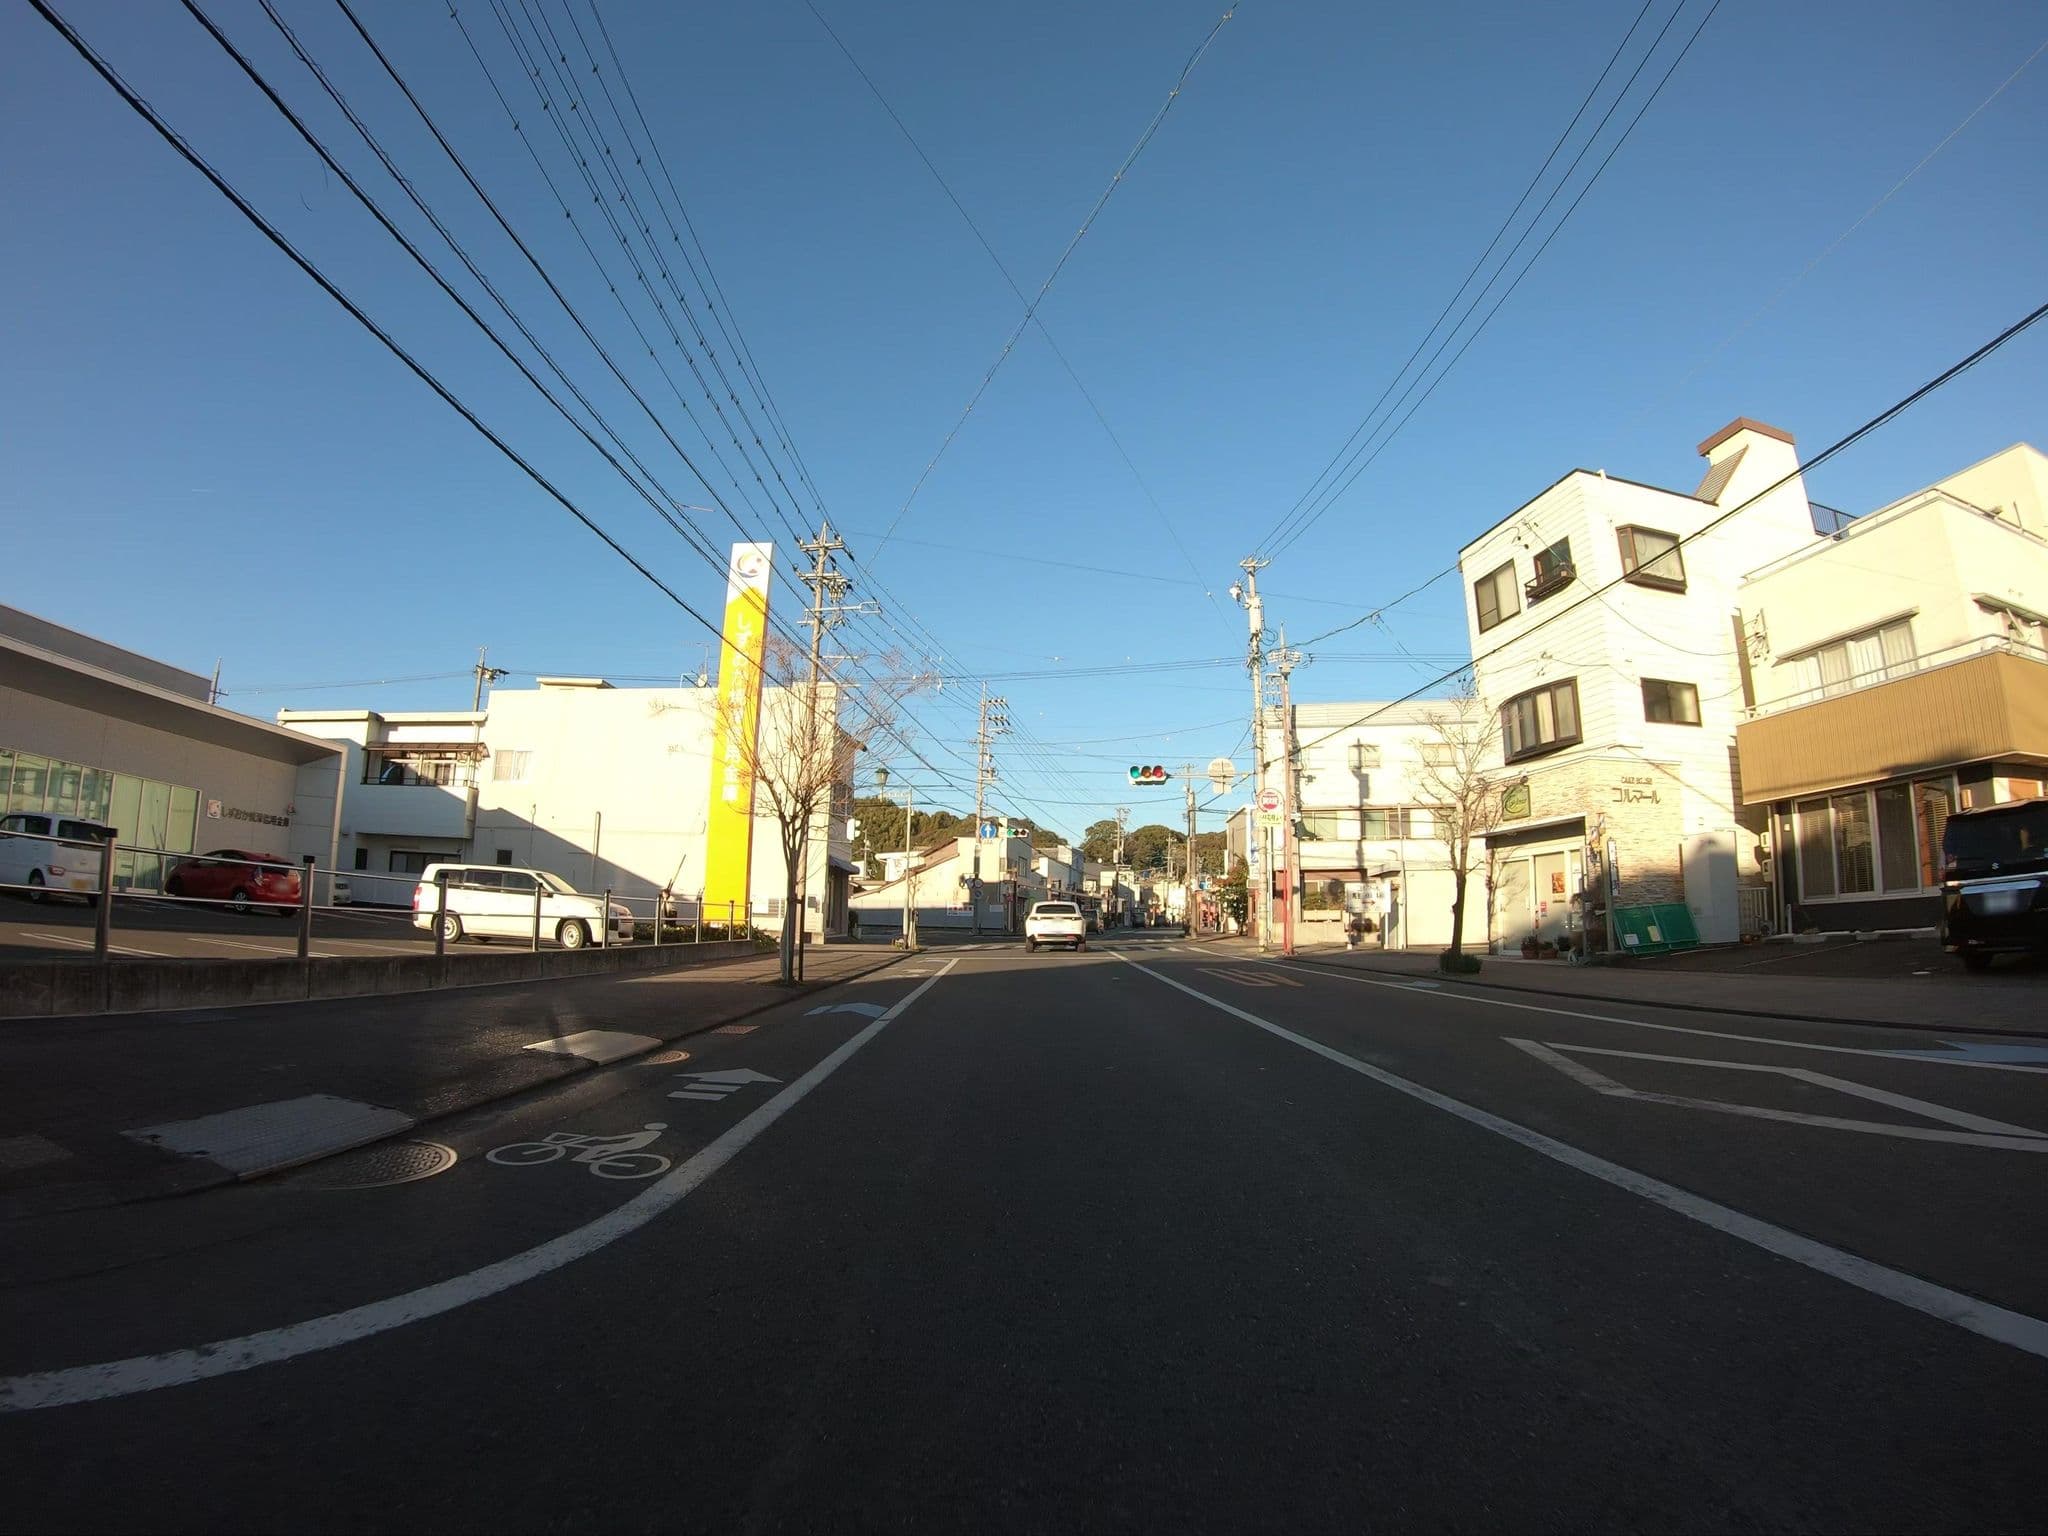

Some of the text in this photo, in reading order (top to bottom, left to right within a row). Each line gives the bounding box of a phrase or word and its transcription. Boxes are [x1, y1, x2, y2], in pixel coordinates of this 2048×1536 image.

[1612, 787, 1661, 805] コルマール
